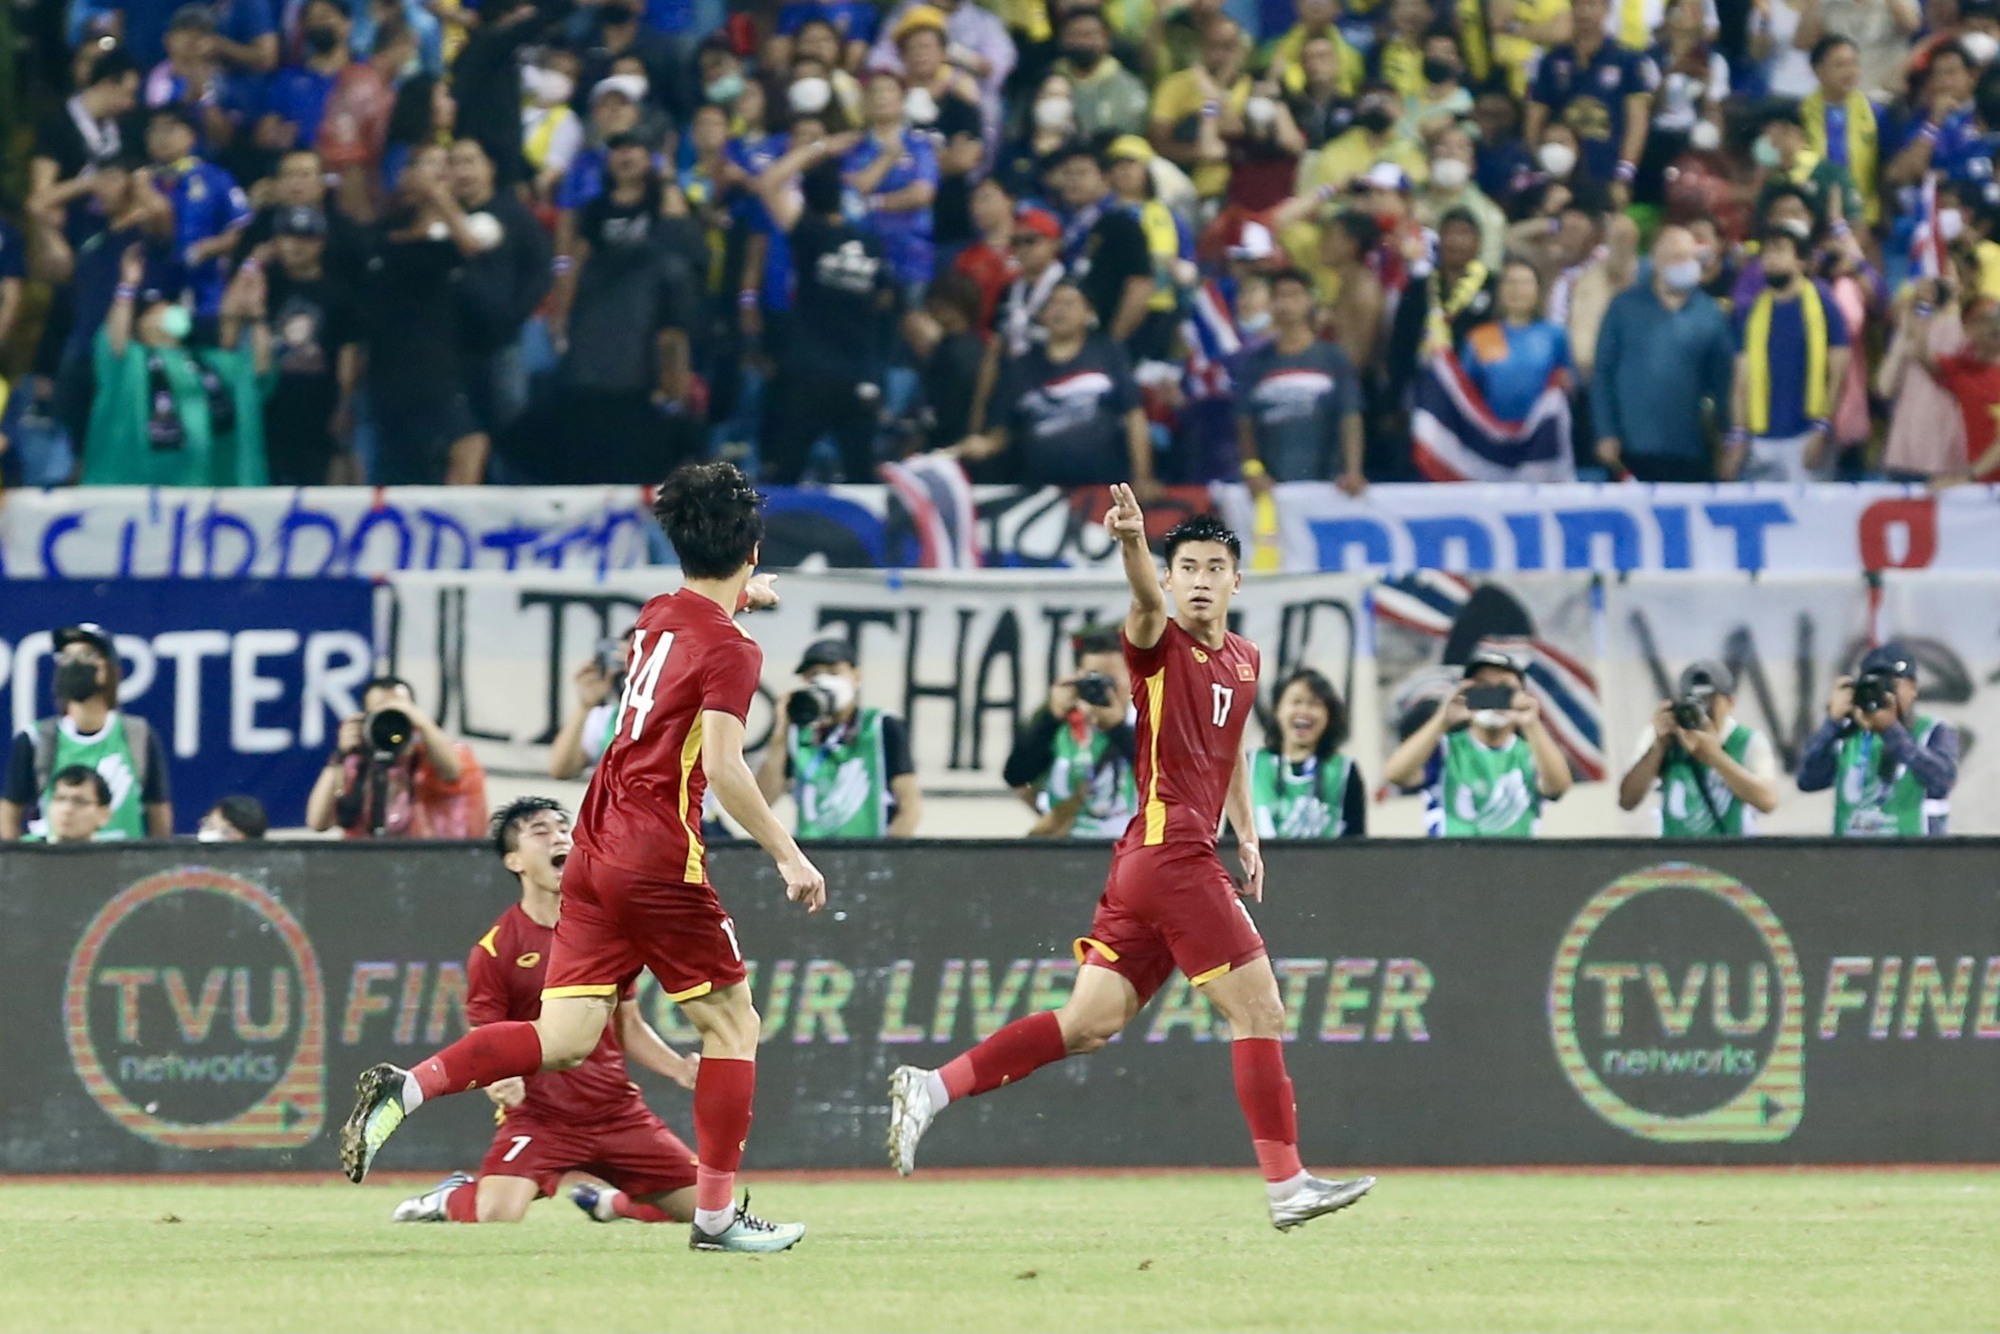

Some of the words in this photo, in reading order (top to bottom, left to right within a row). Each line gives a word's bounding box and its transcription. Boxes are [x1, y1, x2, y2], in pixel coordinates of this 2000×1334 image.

[615, 629, 676, 741] 14
[817, 600, 1354, 769] THAID
[1211, 682, 1235, 728] 17
[98, 966, 291, 1044] TVU
[1582, 962, 1770, 1037] TVU
[119, 1050, 278, 1083] networks
[1602, 1045, 1758, 1076] networks
[502, 1134, 533, 1162] 7
